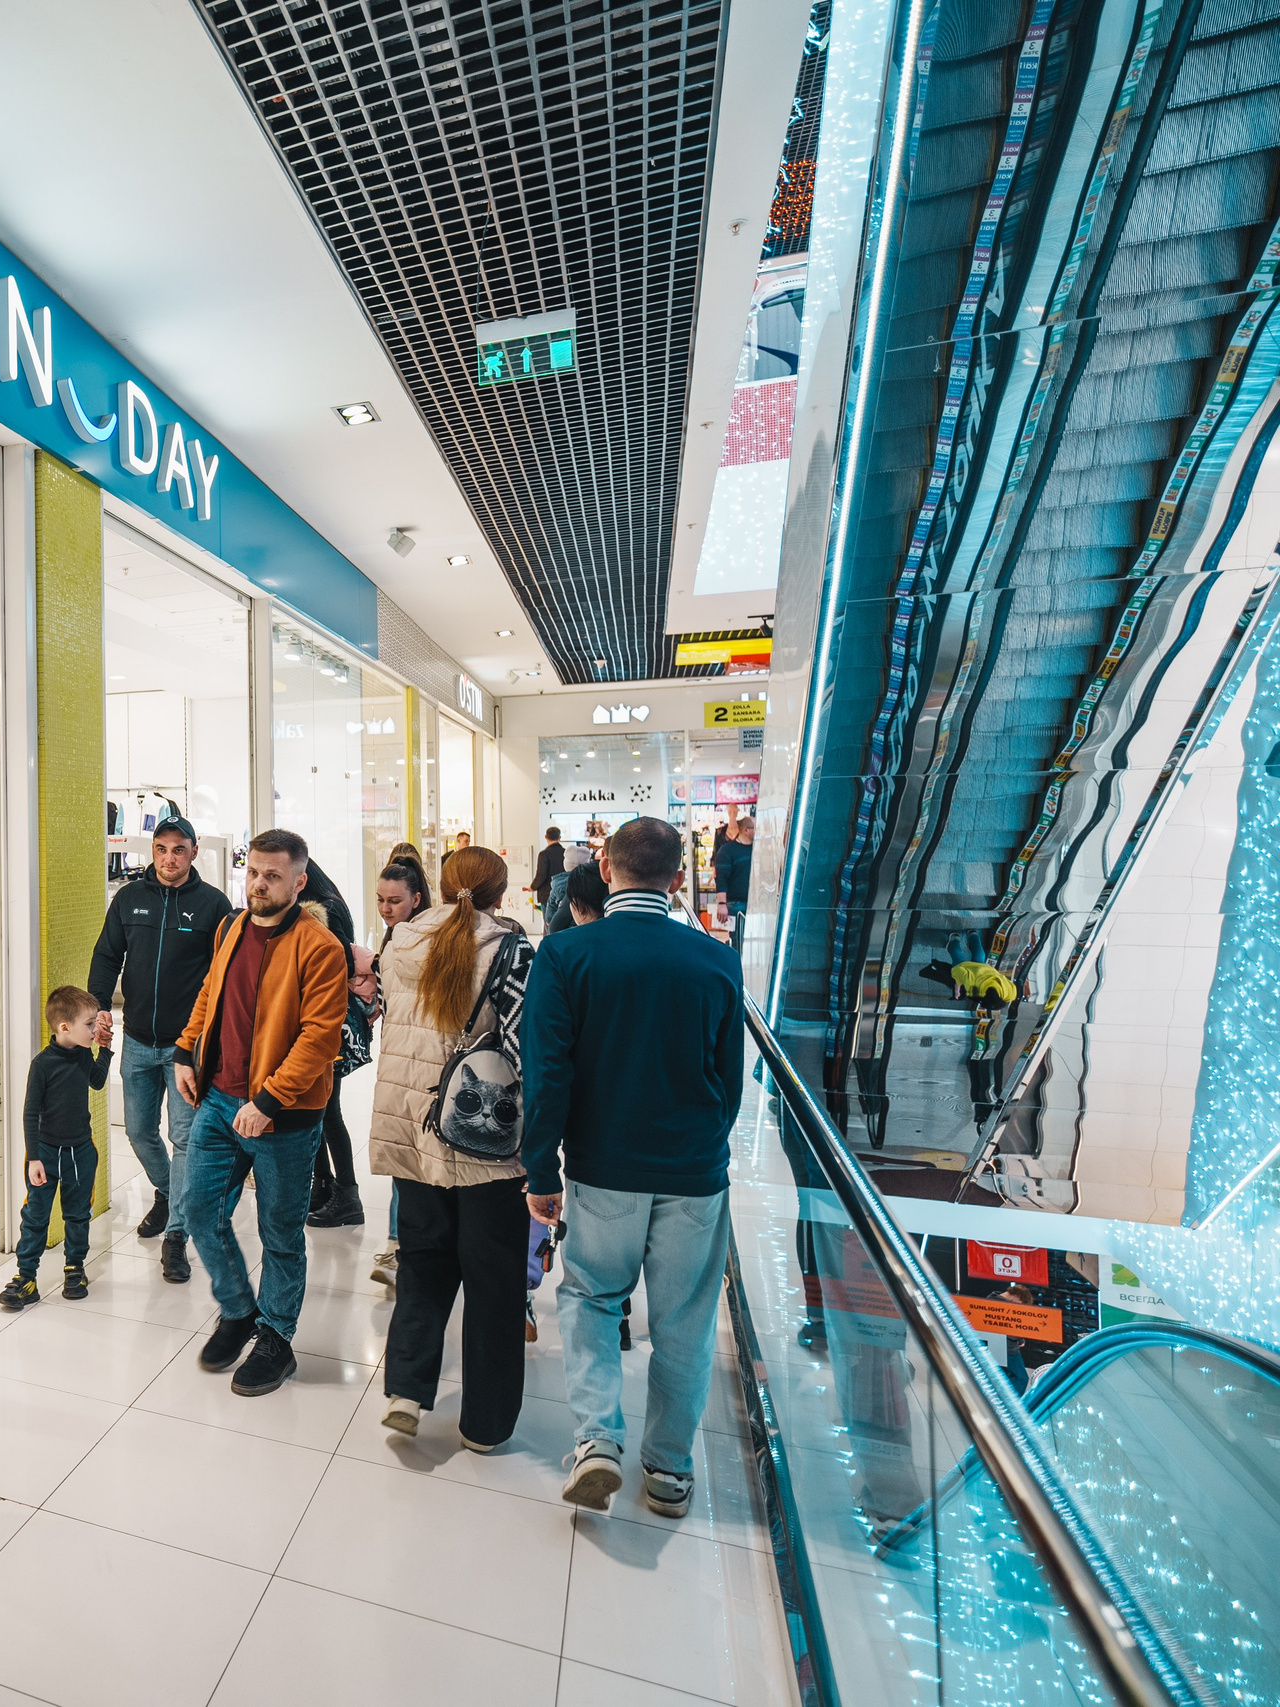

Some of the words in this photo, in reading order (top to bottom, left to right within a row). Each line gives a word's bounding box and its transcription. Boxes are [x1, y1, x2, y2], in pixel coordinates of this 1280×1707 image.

[118, 379, 219, 521] DAY
[714, 707, 728, 722] 2
[570, 789, 616, 801] zakka
[1119, 1293, 1165, 1305] ВСЕГДА
[969, 1303, 1005, 1313] SUNLIGHT
[1012, 1309, 1049, 1319] SOKOLOV
[984, 1313, 1022, 1323] MUSTANG
[983, 1319, 1013, 1329] YSABEL
[1015, 1324, 1040, 1332] MORA
